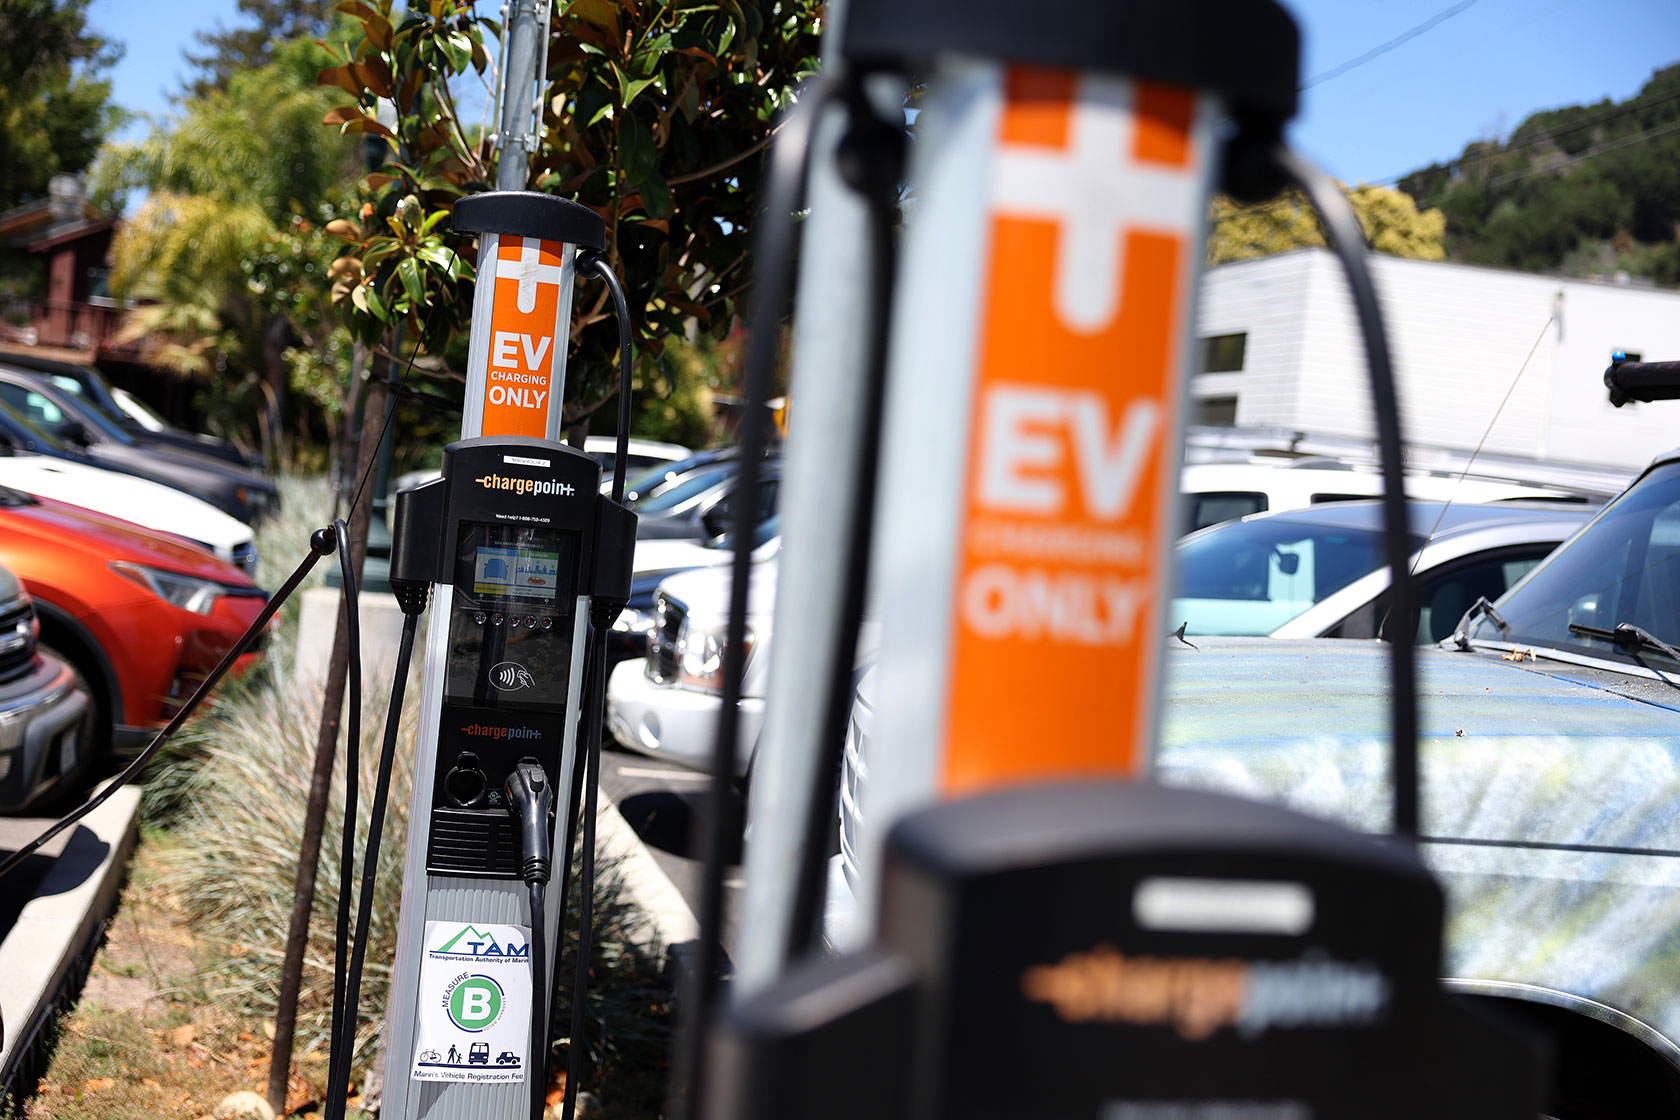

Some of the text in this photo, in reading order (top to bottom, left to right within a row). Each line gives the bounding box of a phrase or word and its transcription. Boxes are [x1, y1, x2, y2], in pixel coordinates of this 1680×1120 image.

[492, 331, 552, 371] EV
[490, 371, 547, 385] CHARGING
[488, 385, 547, 409] ONLY
[980, 386, 1158, 519] EV
[963, 564, 1146, 646] ONLY
[429, 953, 474, 962] Transportation
[475, 956, 503, 965] Authority
[467, 941, 530, 957] TAM
[442, 971, 470, 1008] MEASURE
[461, 986, 492, 1021] B
[413, 1070, 439, 1079] Marin's
[440, 1071, 466, 1080] Vehicle
[467, 1072, 510, 1081] Registration
